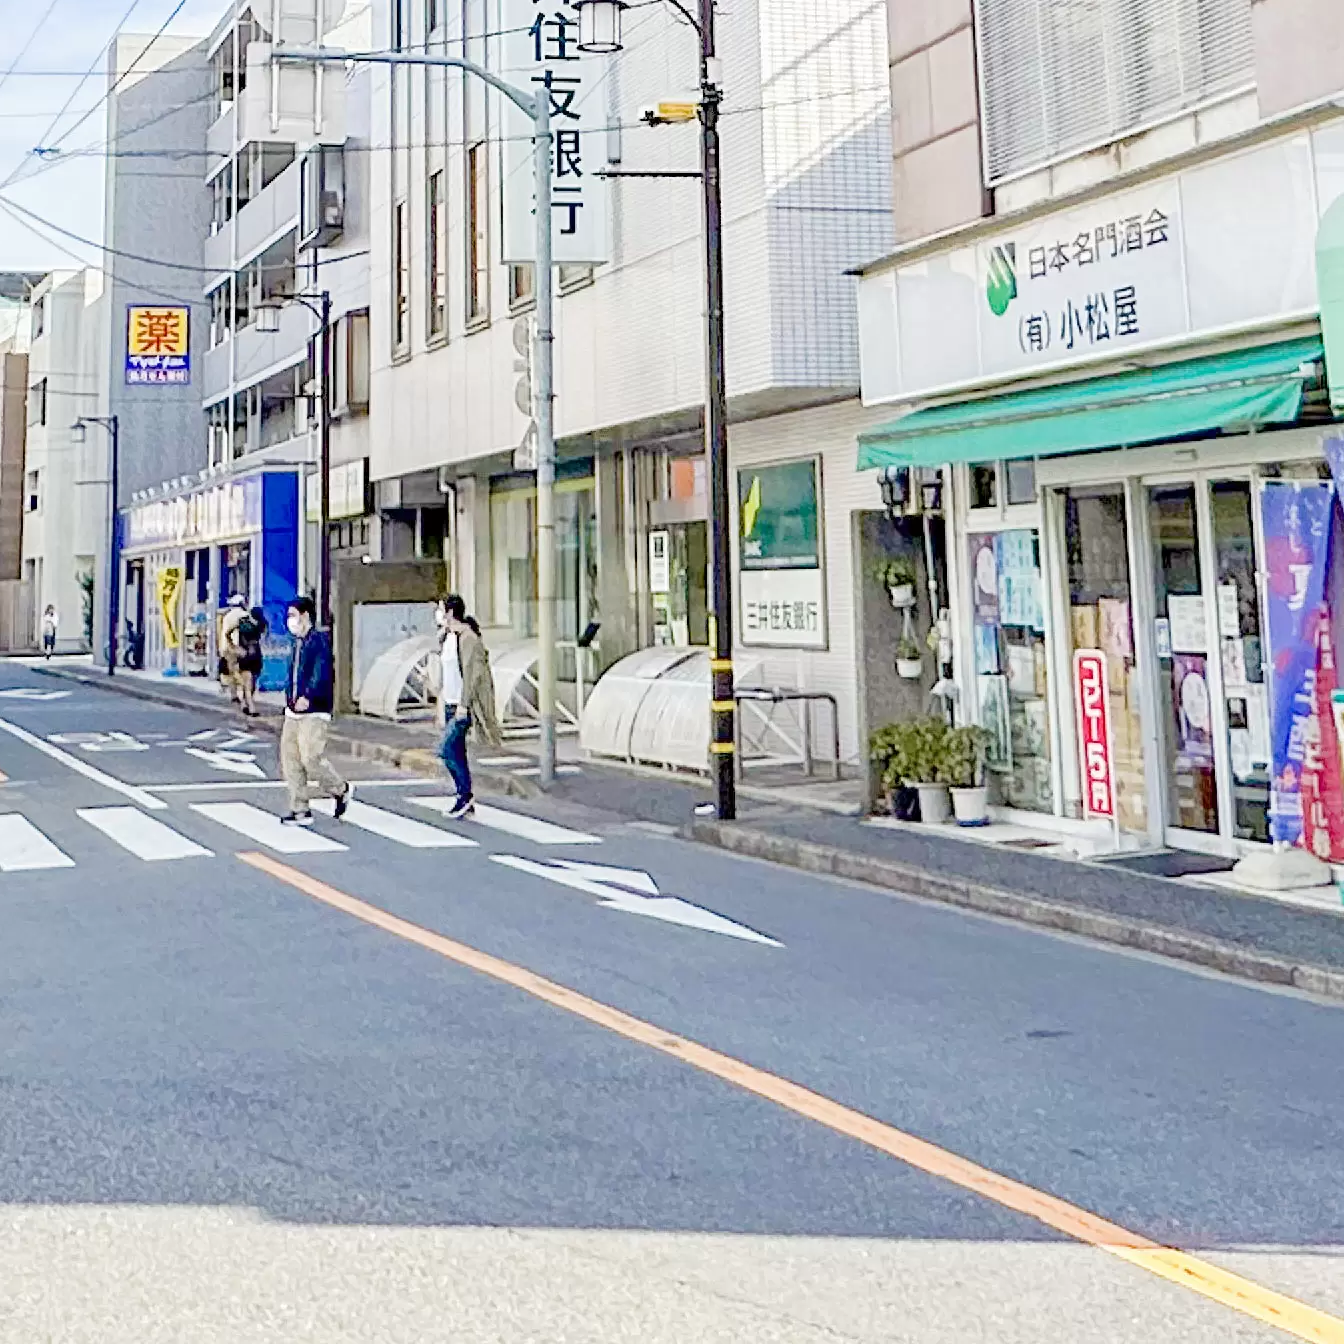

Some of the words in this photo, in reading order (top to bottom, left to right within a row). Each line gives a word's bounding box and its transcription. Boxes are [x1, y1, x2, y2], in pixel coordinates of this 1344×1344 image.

[1027, 207, 1170, 281] 日本名門酒会
[136, 310, 180, 353] 薬
